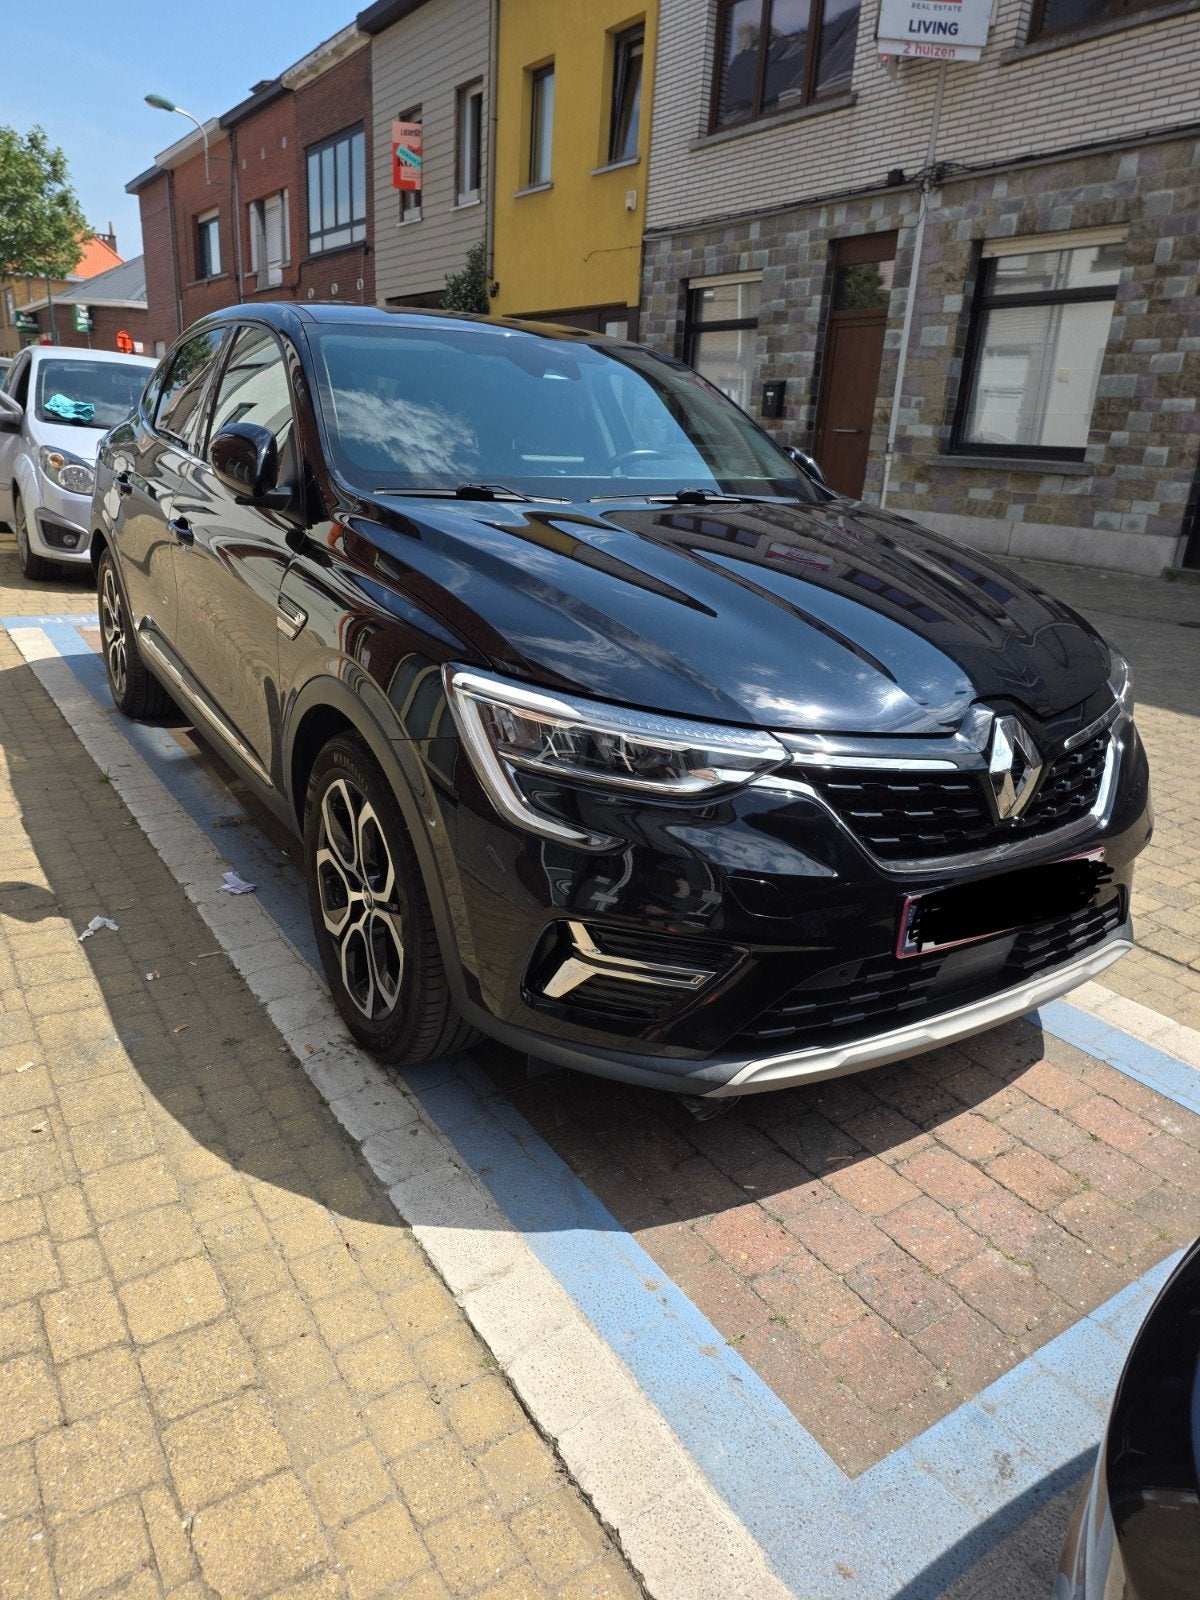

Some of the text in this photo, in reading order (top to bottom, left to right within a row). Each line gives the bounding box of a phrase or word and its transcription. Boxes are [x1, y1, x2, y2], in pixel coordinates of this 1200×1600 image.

[911, 2, 962, 12] REAL ESTATE
[908, 19, 959, 36] LIVING
[903, 40, 956, 59] 2 huizen
